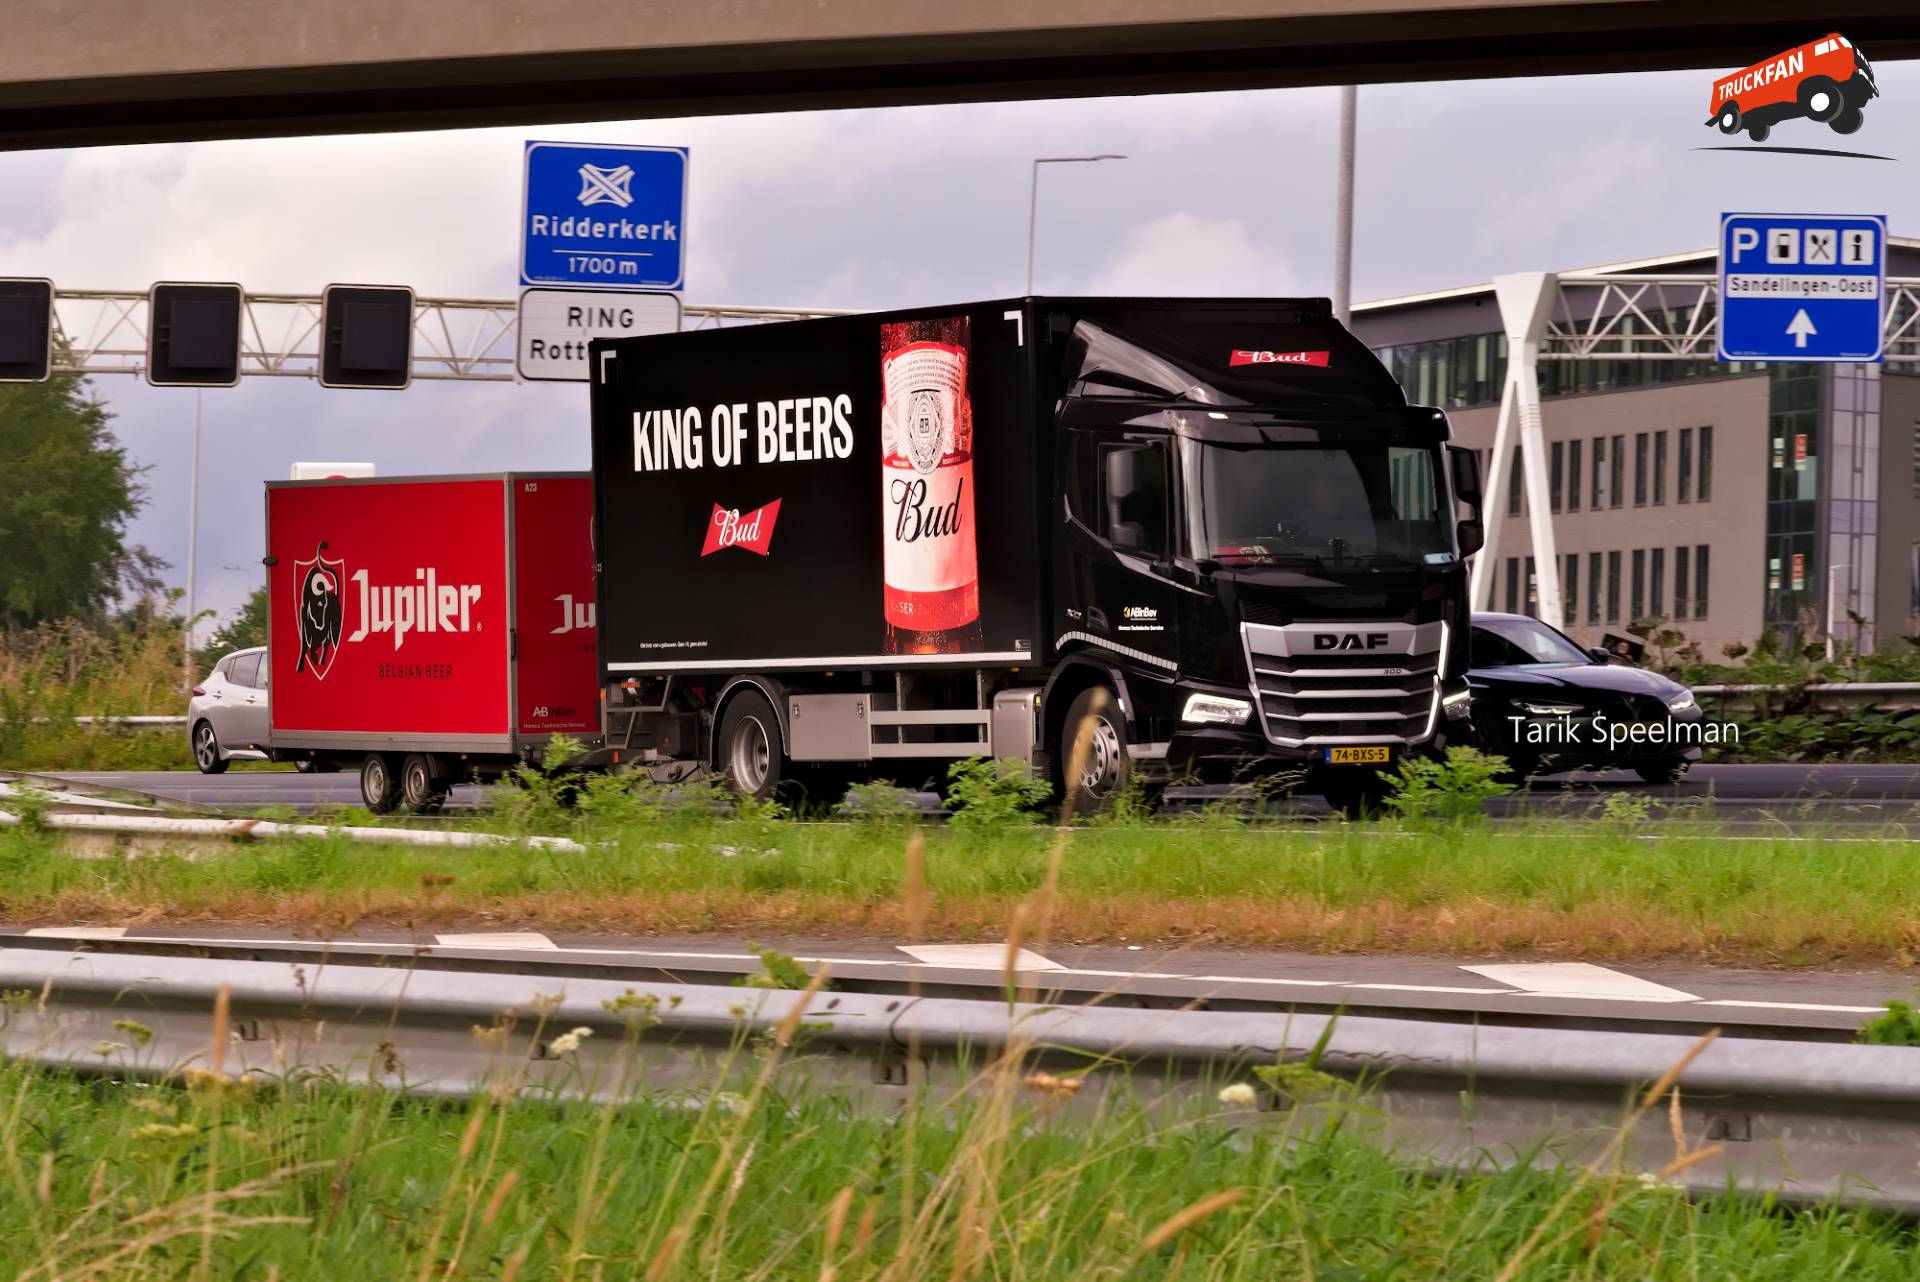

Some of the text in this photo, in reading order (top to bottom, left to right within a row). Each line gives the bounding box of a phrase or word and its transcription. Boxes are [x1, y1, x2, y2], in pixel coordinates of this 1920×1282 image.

[531, 215, 678, 241] Ridderkerk
[1732, 228, 1760, 264] P
[568, 256, 638, 275] 1700 m
[1730, 276, 1873, 297] Sandelingen-Oost
[568, 306, 634, 329] RING
[1237, 350, 1311, 363] Bud
[633, 393, 854, 472] KING OF BEERS
[524, 483, 537, 492] A23
[891, 477, 963, 543] Bud
[715, 508, 762, 546] Bud
[347, 568, 482, 651] Jupiler
[1314, 633, 1388, 650] DAF
[379, 664, 453, 678] BELGIAN BEER
[1335, 749, 1385, 761] 74-BXS-5
